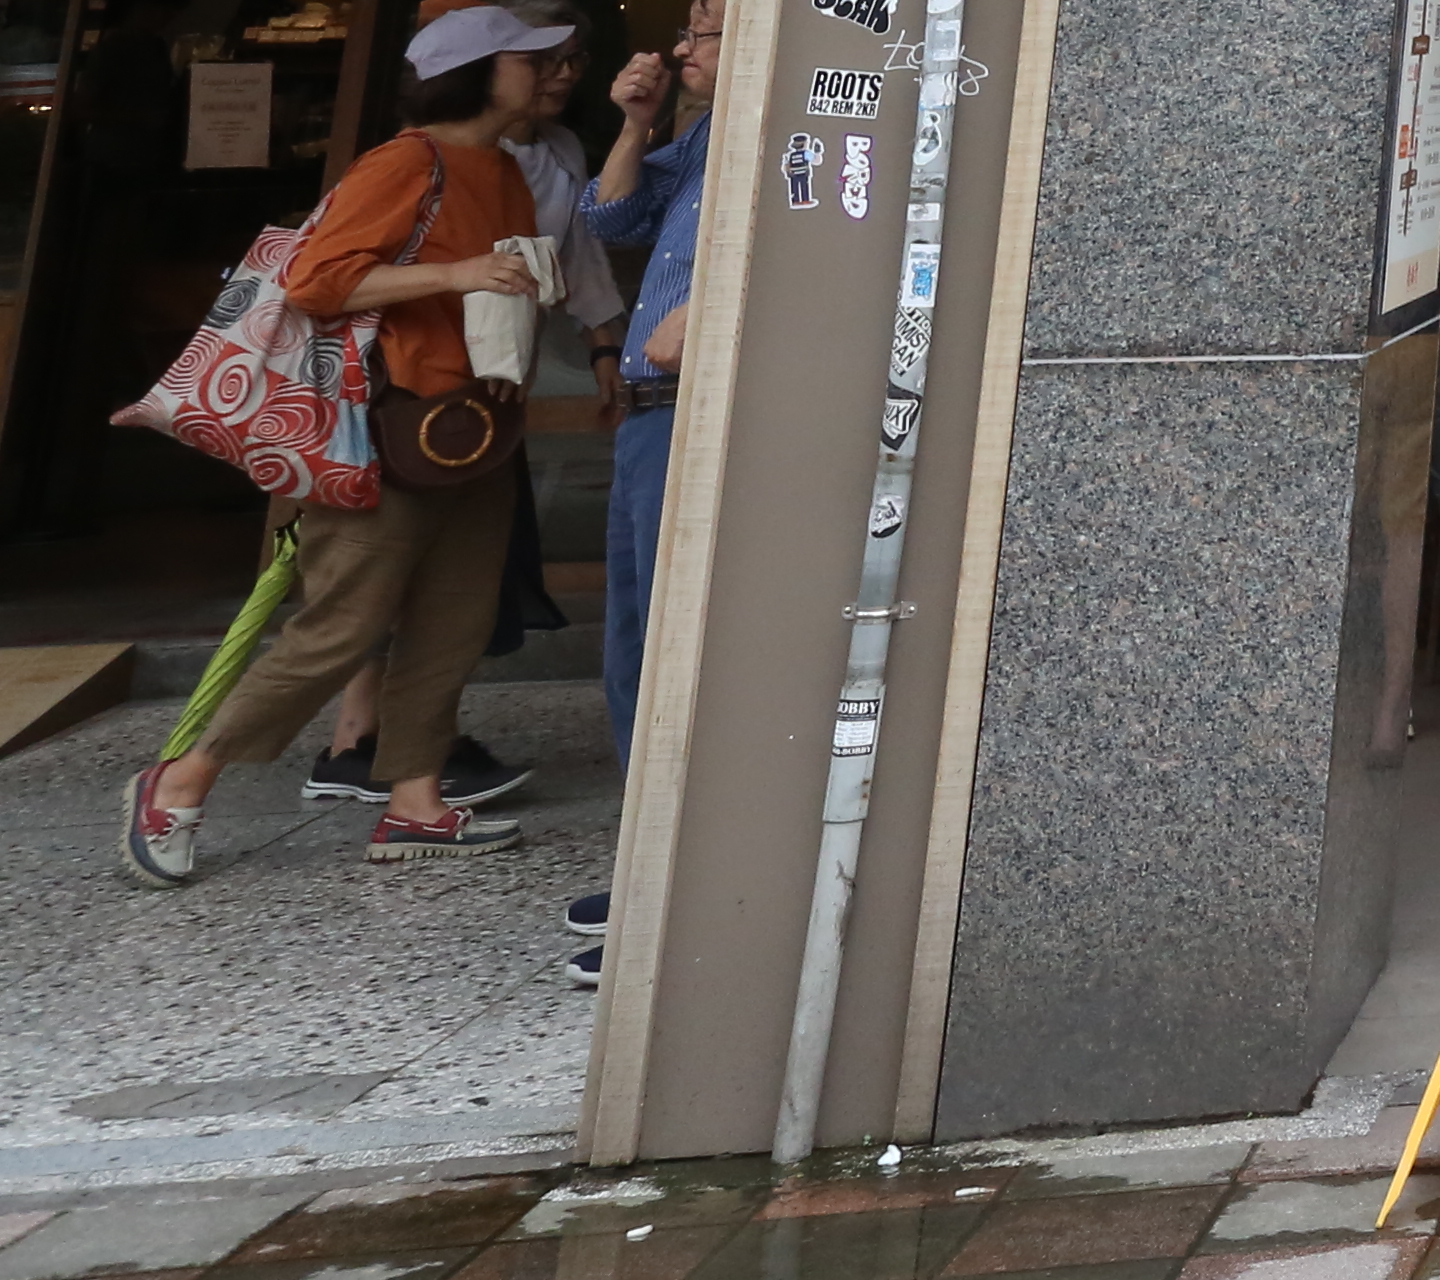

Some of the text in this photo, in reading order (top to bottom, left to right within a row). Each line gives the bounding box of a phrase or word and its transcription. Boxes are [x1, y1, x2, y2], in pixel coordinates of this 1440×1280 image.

[813, 70, 882, 101] ROOTS
[809, 98, 829, 114] 842
[831, 101, 853, 116] REM
